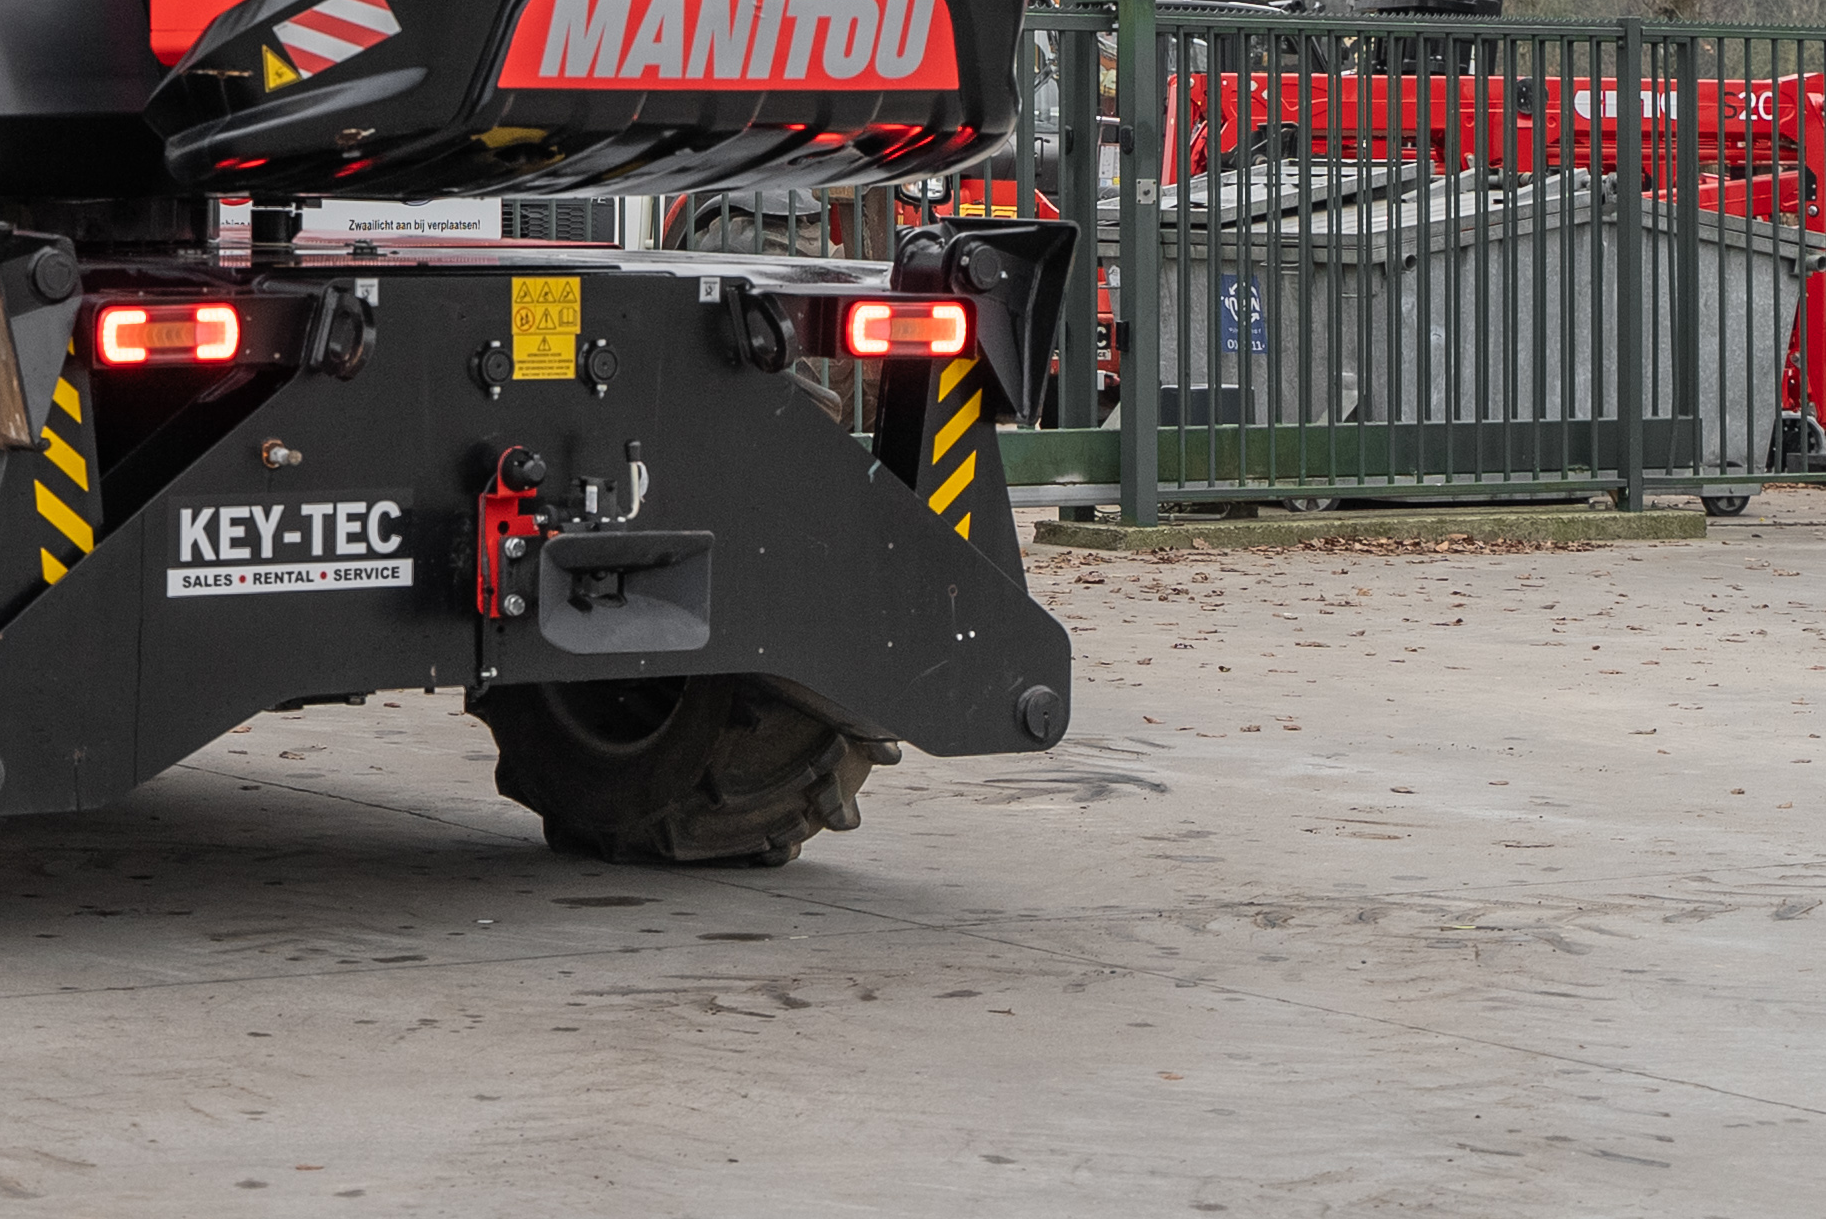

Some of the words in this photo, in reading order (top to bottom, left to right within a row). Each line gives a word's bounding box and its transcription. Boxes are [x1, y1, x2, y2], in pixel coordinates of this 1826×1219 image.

[348, 219, 394, 231] Zwaailicht
[396, 221, 412, 230] aan
[414, 219, 425, 232] bij
[427, 219, 481, 232] verplaatsen!
[179, 500, 403, 562] KEY-TEC
[182, 573, 233, 589] SALES
[252, 570, 315, 585] RENTAL
[333, 566, 401, 582] SERVICE
